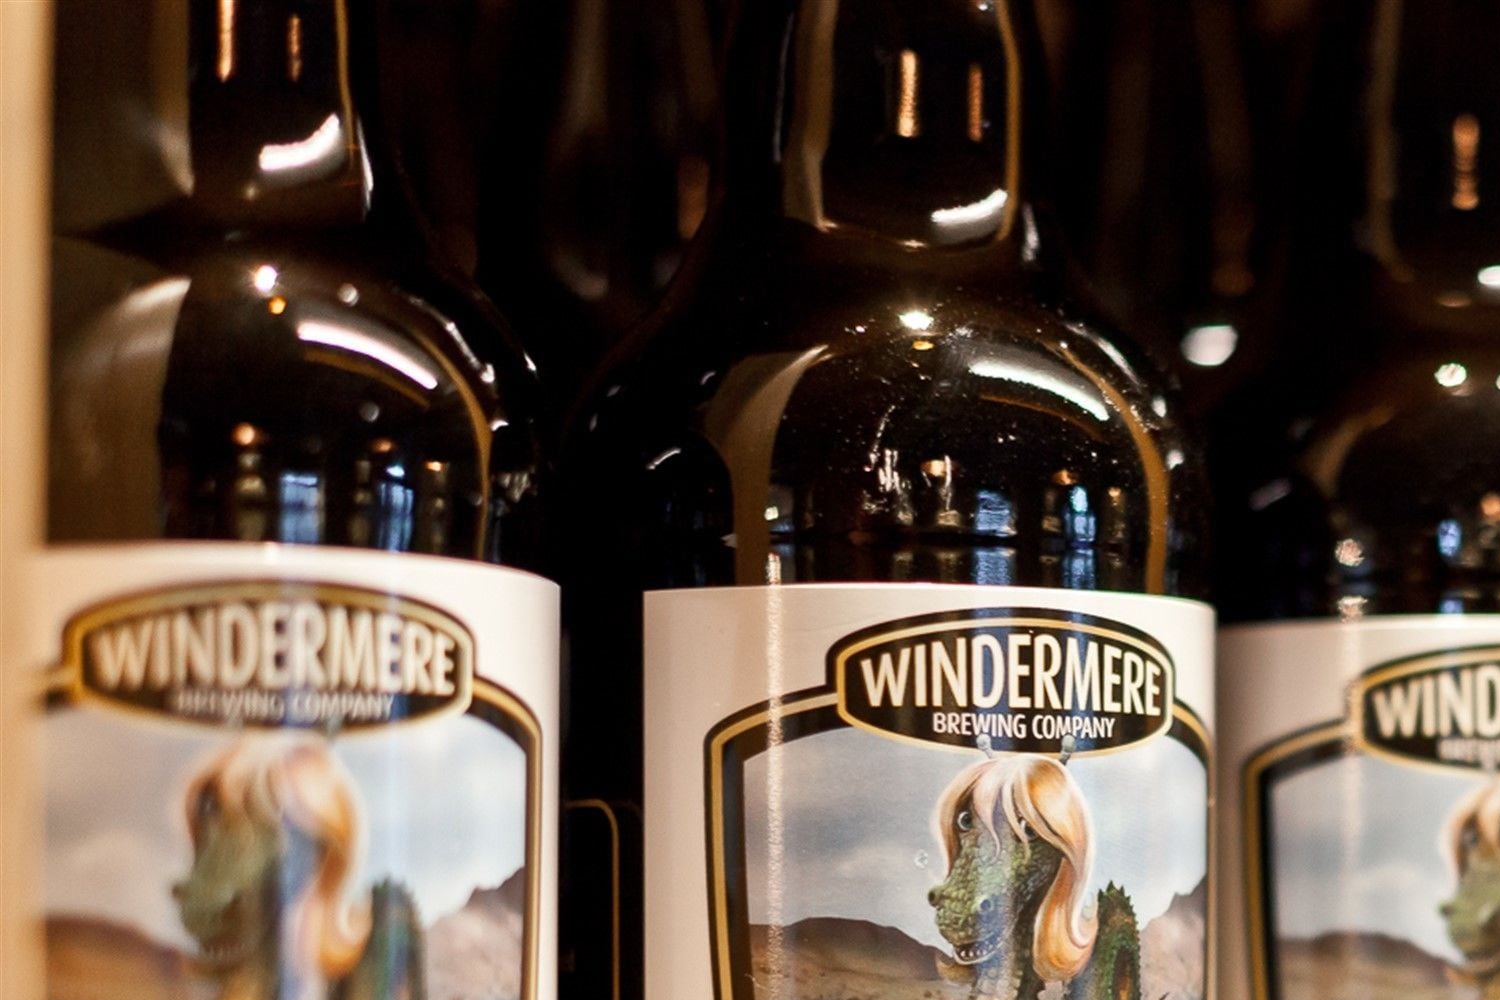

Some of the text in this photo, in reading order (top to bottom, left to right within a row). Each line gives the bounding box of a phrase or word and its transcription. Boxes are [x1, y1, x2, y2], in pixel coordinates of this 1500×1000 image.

[97, 600, 458, 697] WINDERMERE
[860, 633, 1161, 717] WINDERMERE
[933, 712, 1115, 740] BREWING COMPANY
